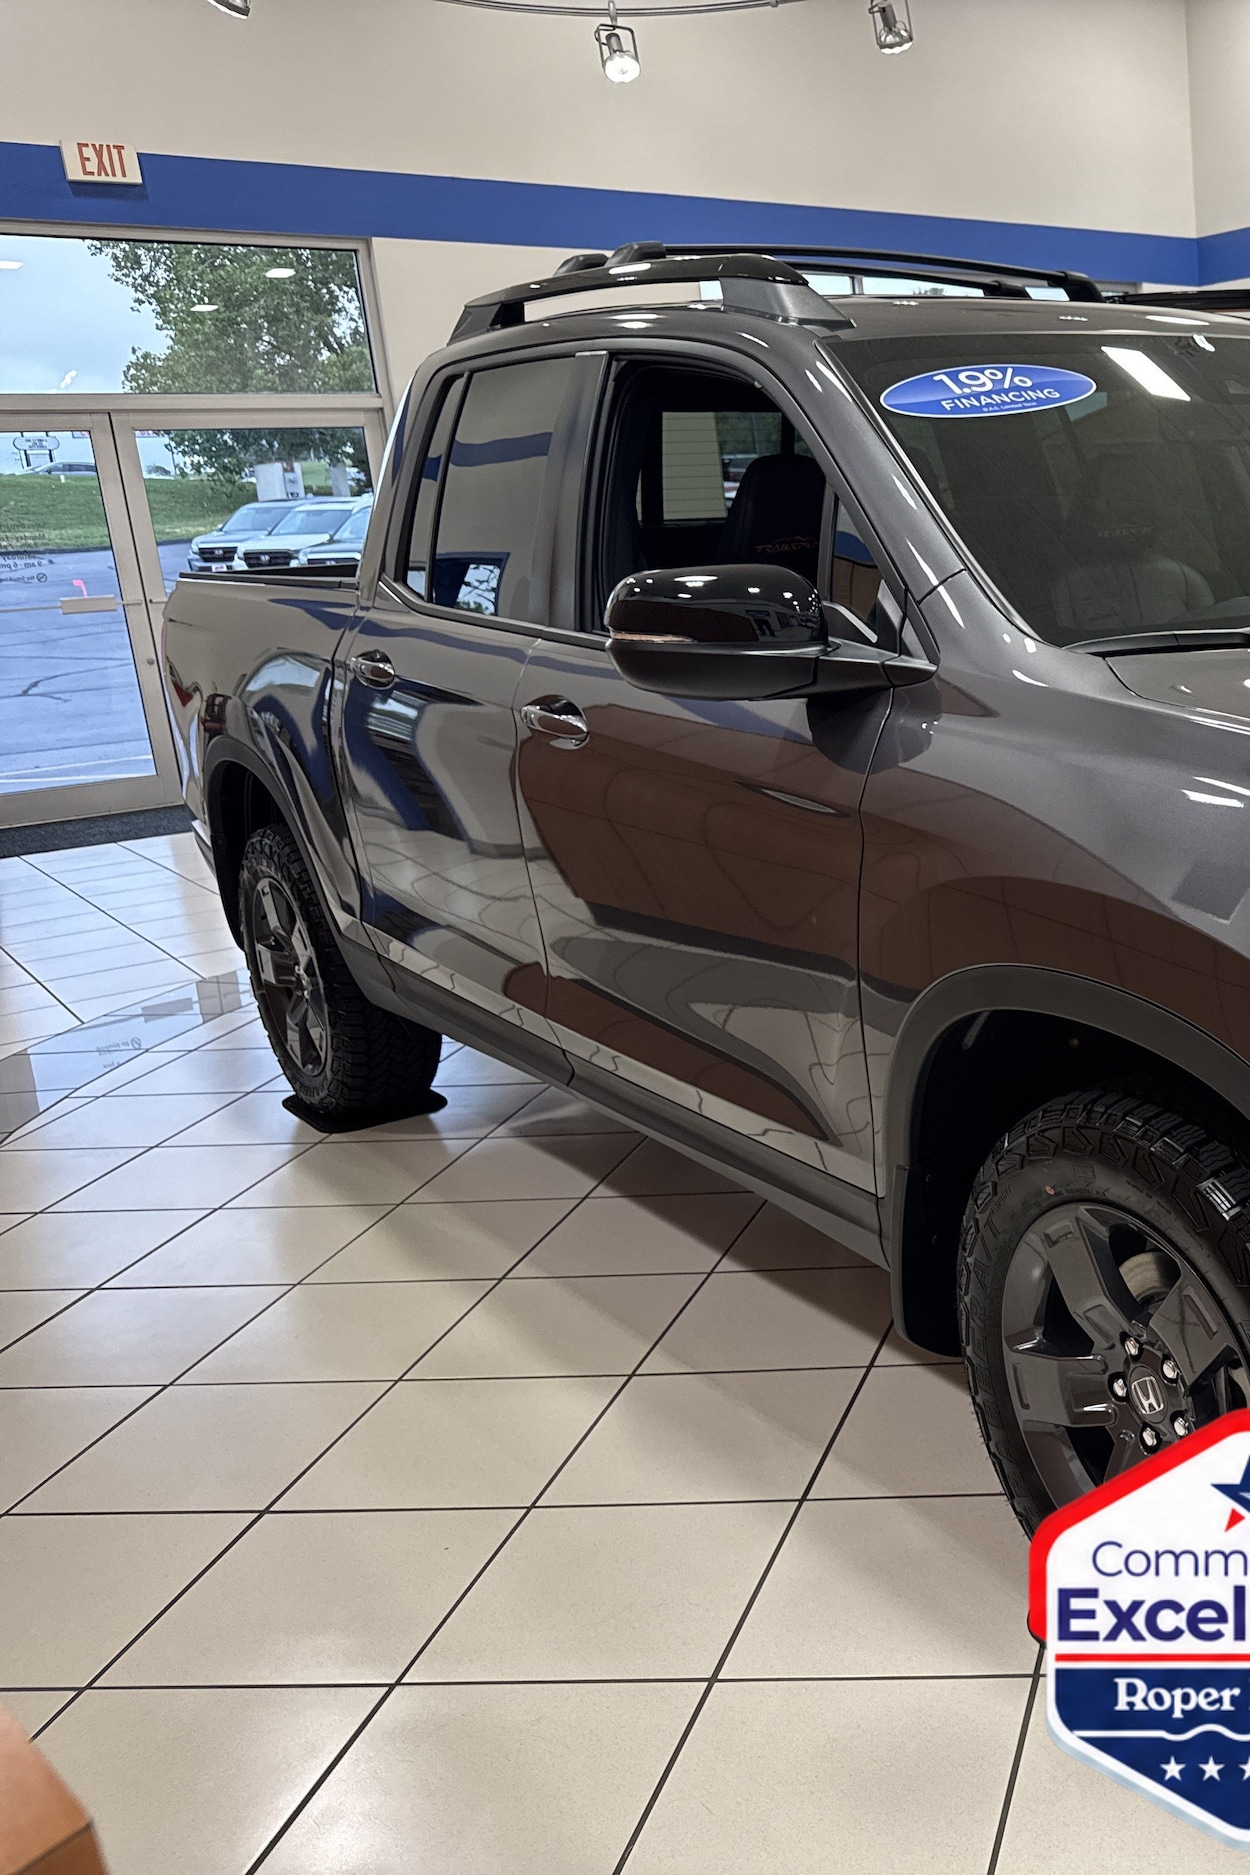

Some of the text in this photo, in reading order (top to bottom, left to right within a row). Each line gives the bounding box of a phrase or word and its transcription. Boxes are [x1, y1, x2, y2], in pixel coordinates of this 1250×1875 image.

[76, 142, 127, 178] EXIT
[932, 367, 1033, 395] 1.9%
[940, 388, 1061, 411] FINANCING
